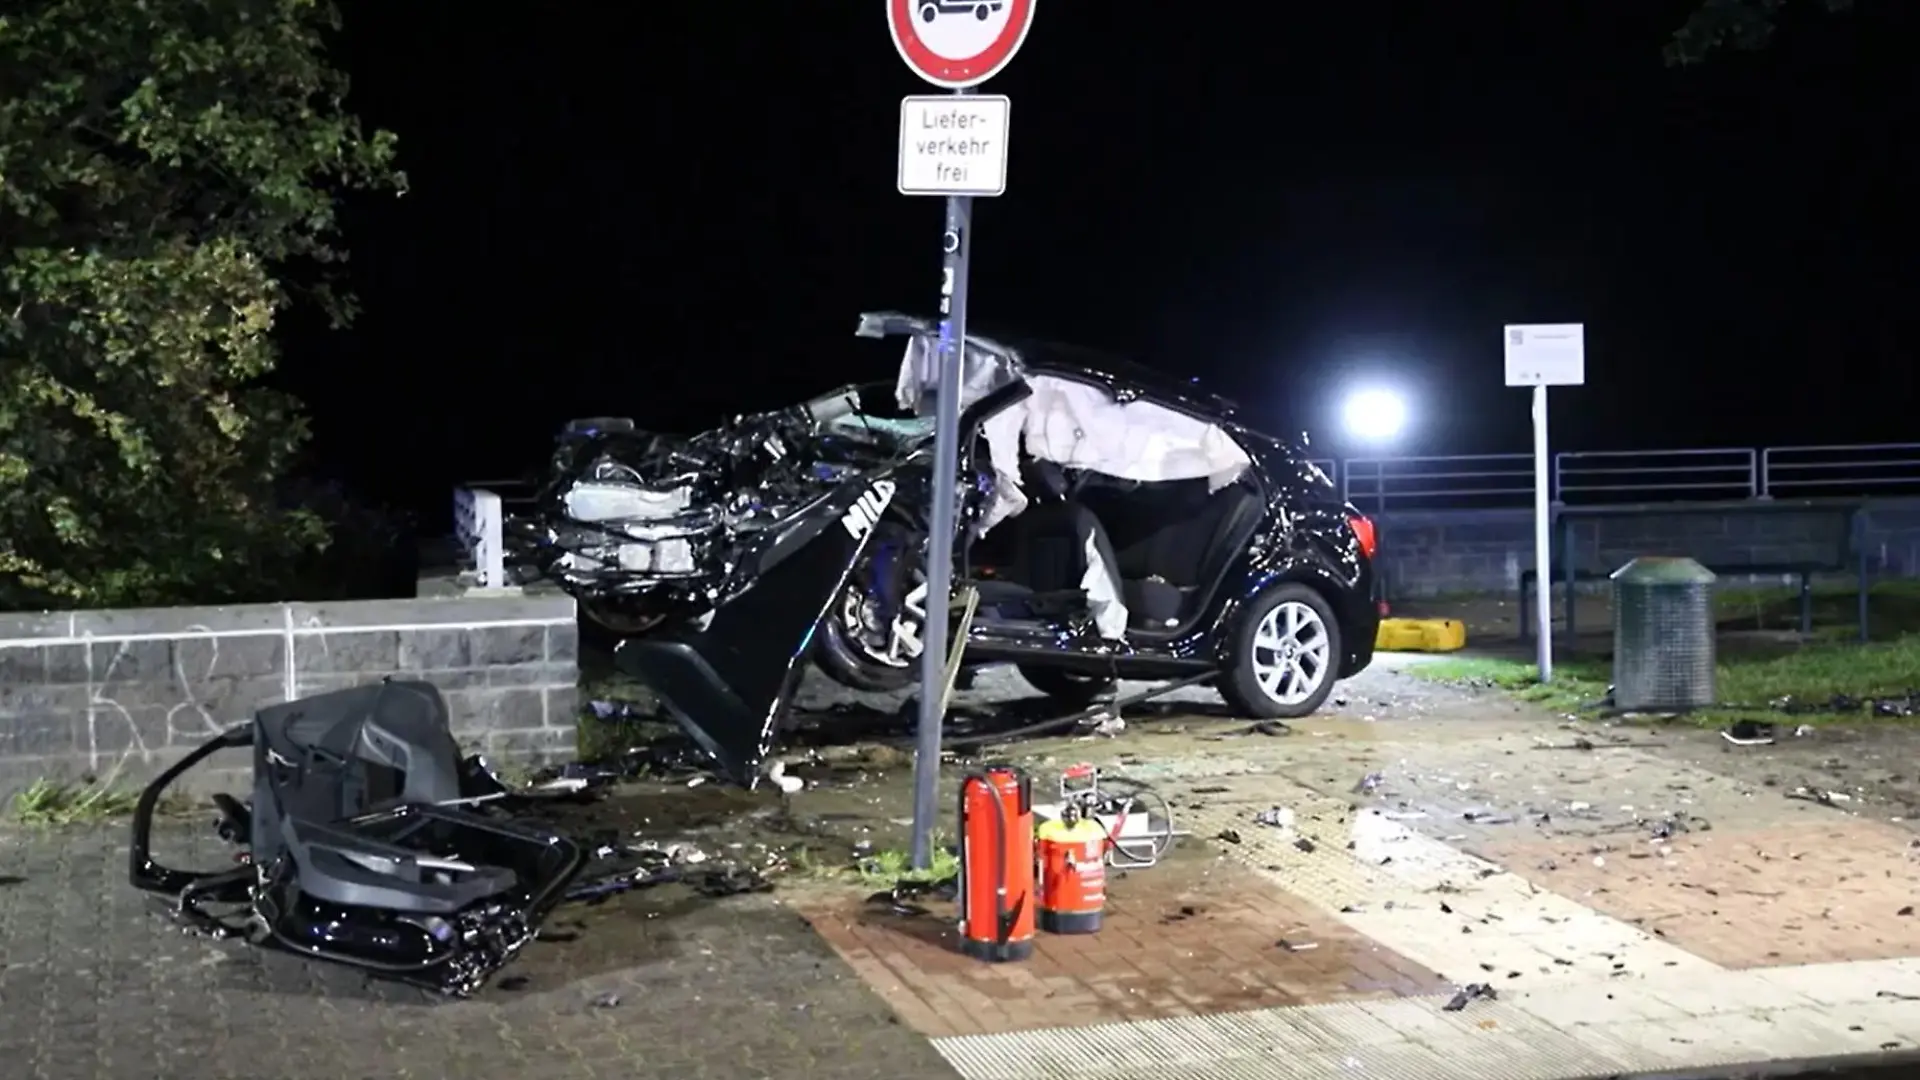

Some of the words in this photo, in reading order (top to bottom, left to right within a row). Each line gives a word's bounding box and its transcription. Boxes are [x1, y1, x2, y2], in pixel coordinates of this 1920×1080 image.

[921, 107, 987, 130] Liefer-
[916, 135, 990, 156] verkehr
[936, 161, 969, 182] frei
